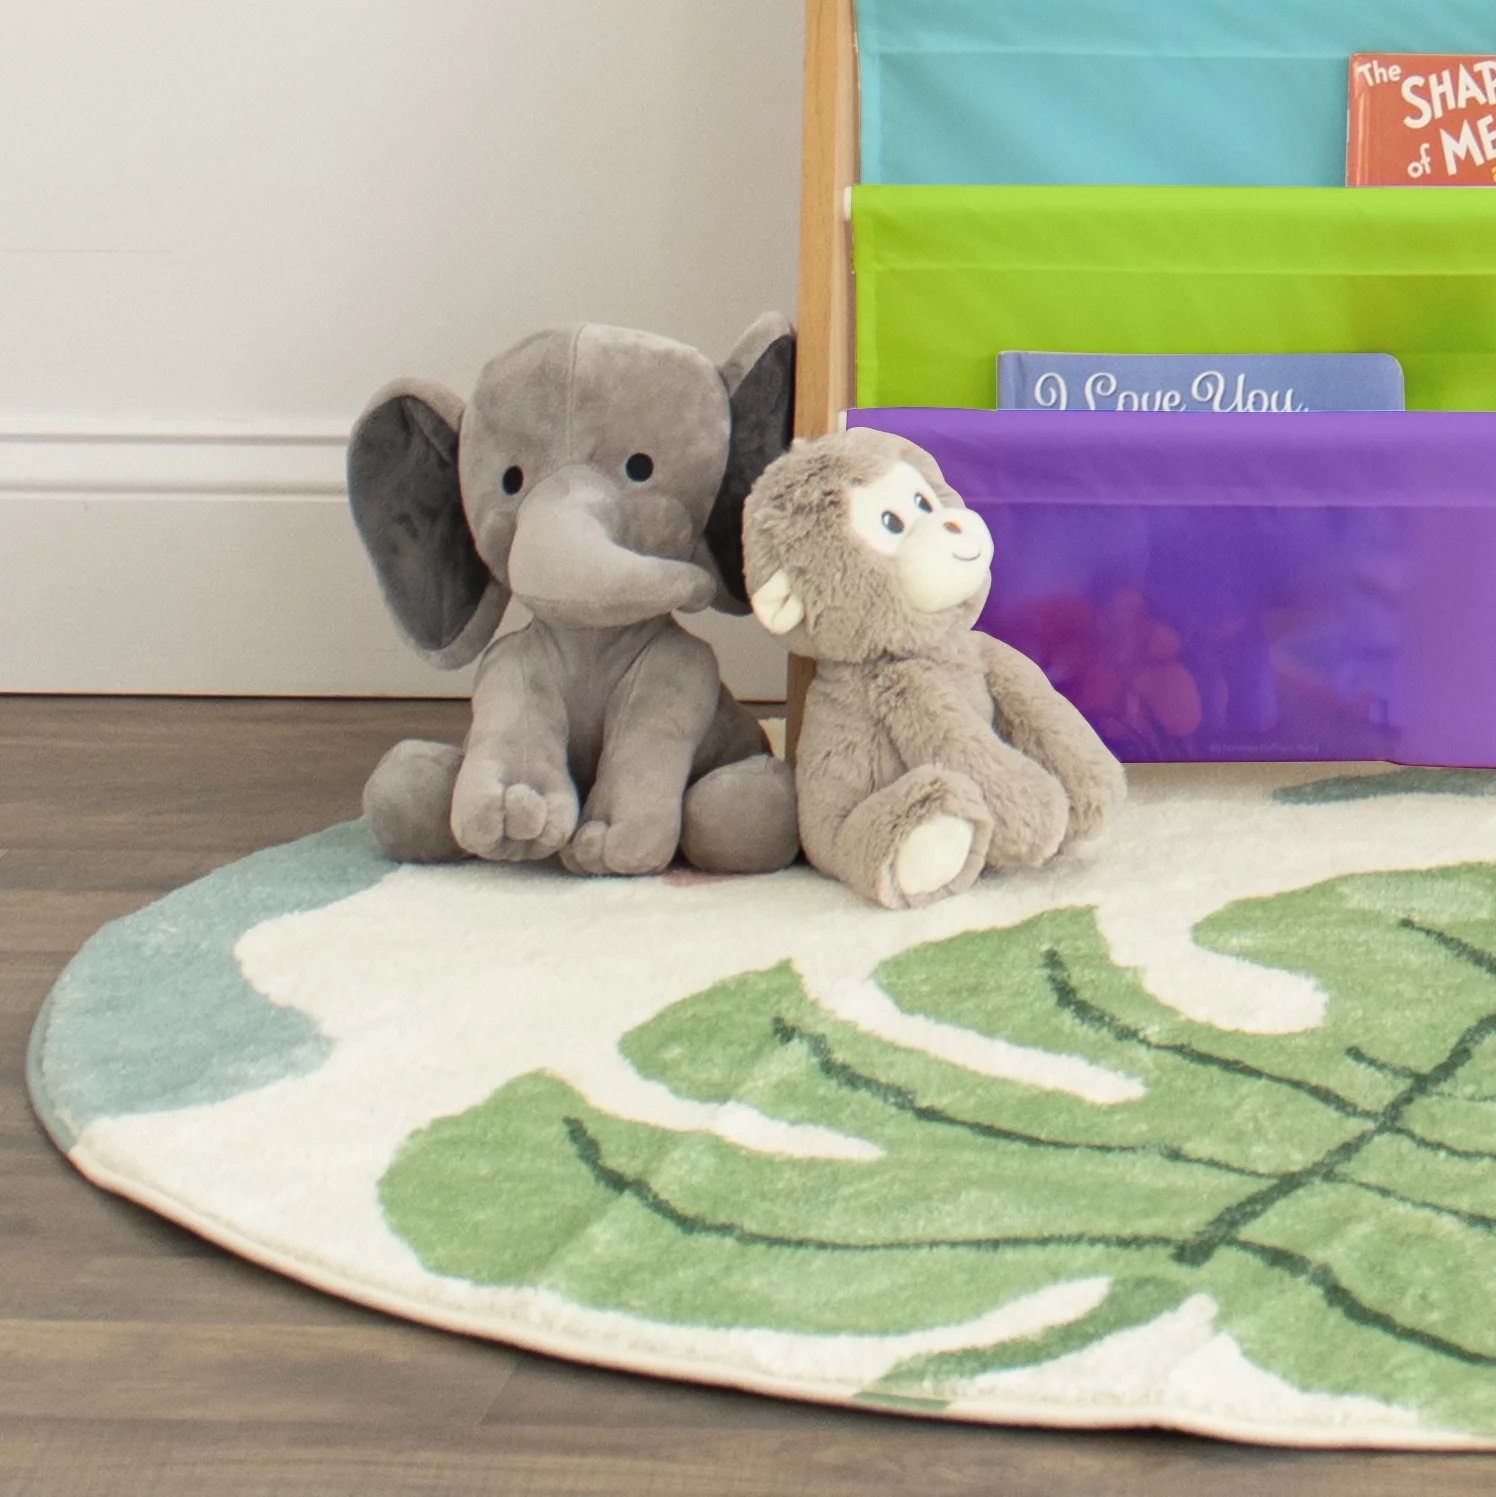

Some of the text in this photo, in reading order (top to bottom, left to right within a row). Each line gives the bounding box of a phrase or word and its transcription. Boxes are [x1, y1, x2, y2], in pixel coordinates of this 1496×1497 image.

[1356, 60, 1402, 87] The
[1407, 143, 1432, 178] of
[1085, 372, 1187, 412] Love
